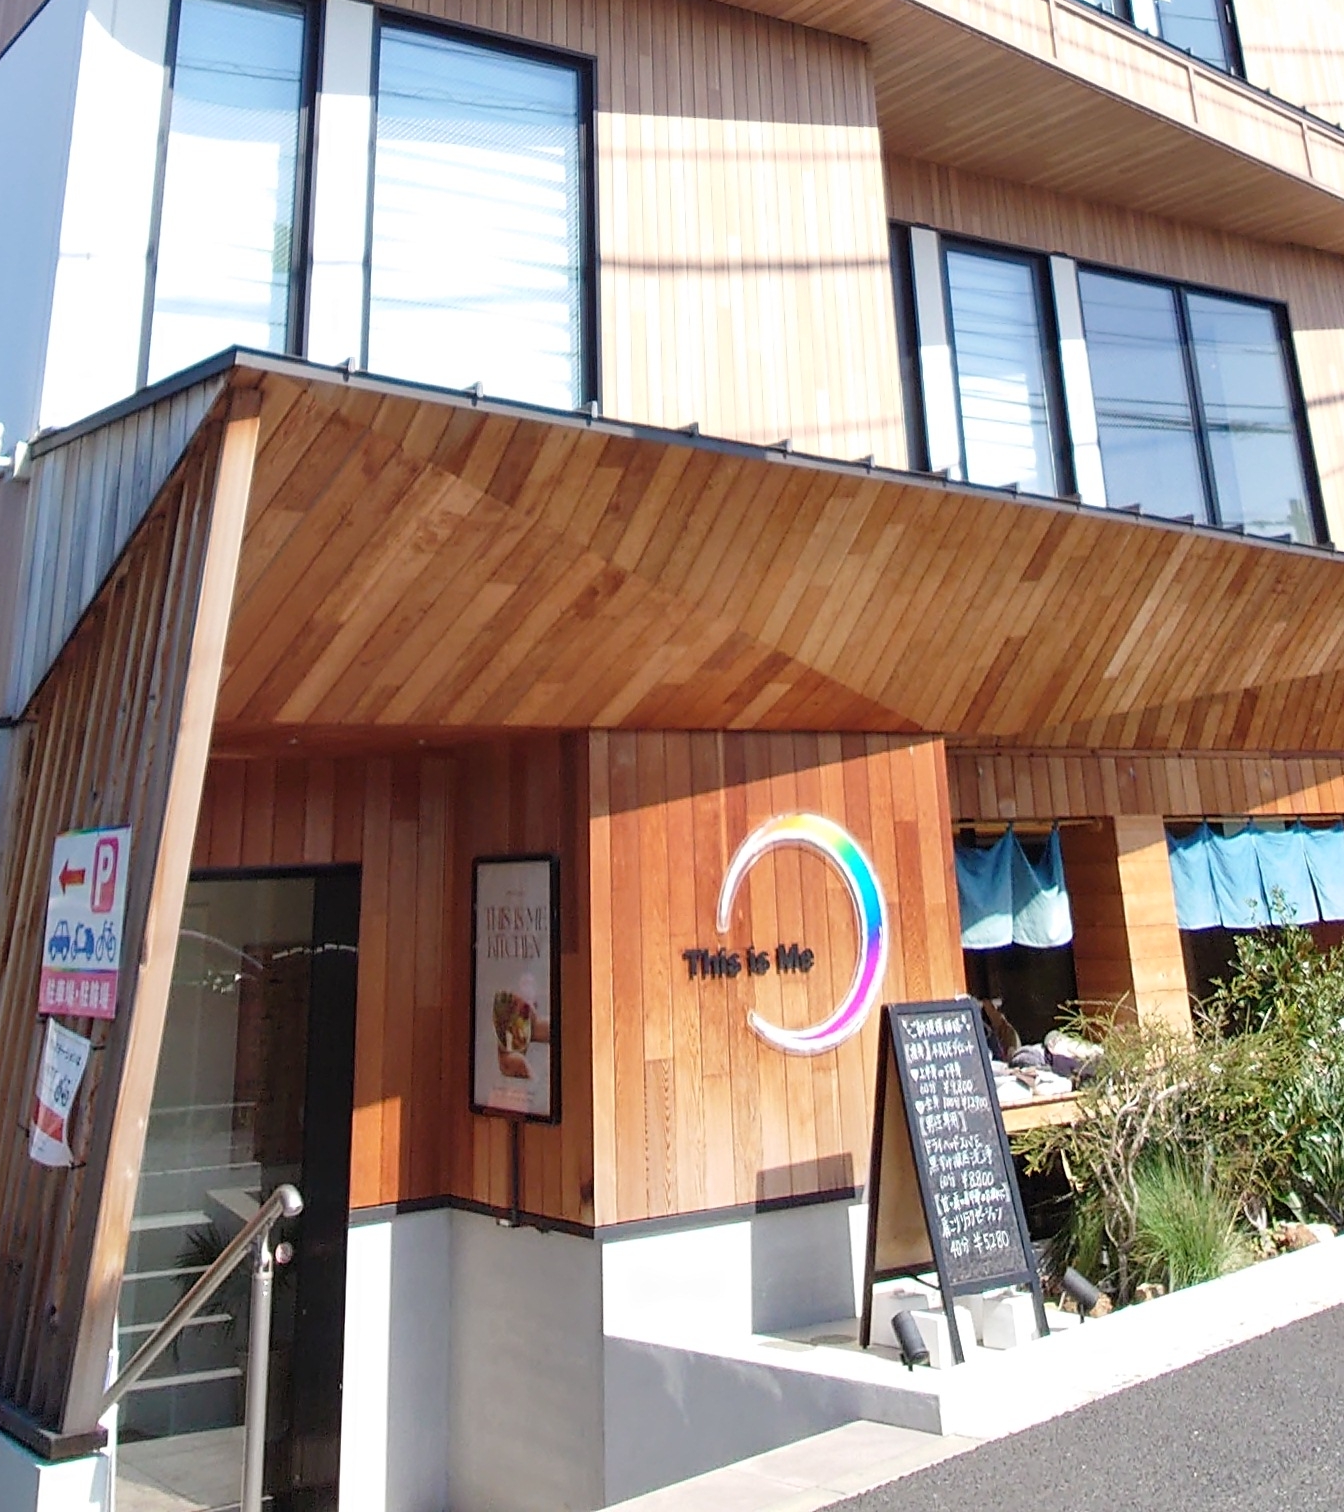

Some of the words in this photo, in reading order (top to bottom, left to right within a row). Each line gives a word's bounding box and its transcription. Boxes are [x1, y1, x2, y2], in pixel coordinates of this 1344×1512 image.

[94, 844, 114, 907] P
[486, 906, 510, 930] THIS
[513, 906, 524, 930] IS
[526, 906, 548, 930] ME
[486, 934, 541, 959] KITCHEN
[682, 947, 742, 980] This
[746, 945, 770, 976] is
[776, 943, 815, 974] Me
[46, 978, 110, 1009] 駐車場・駐輪場
